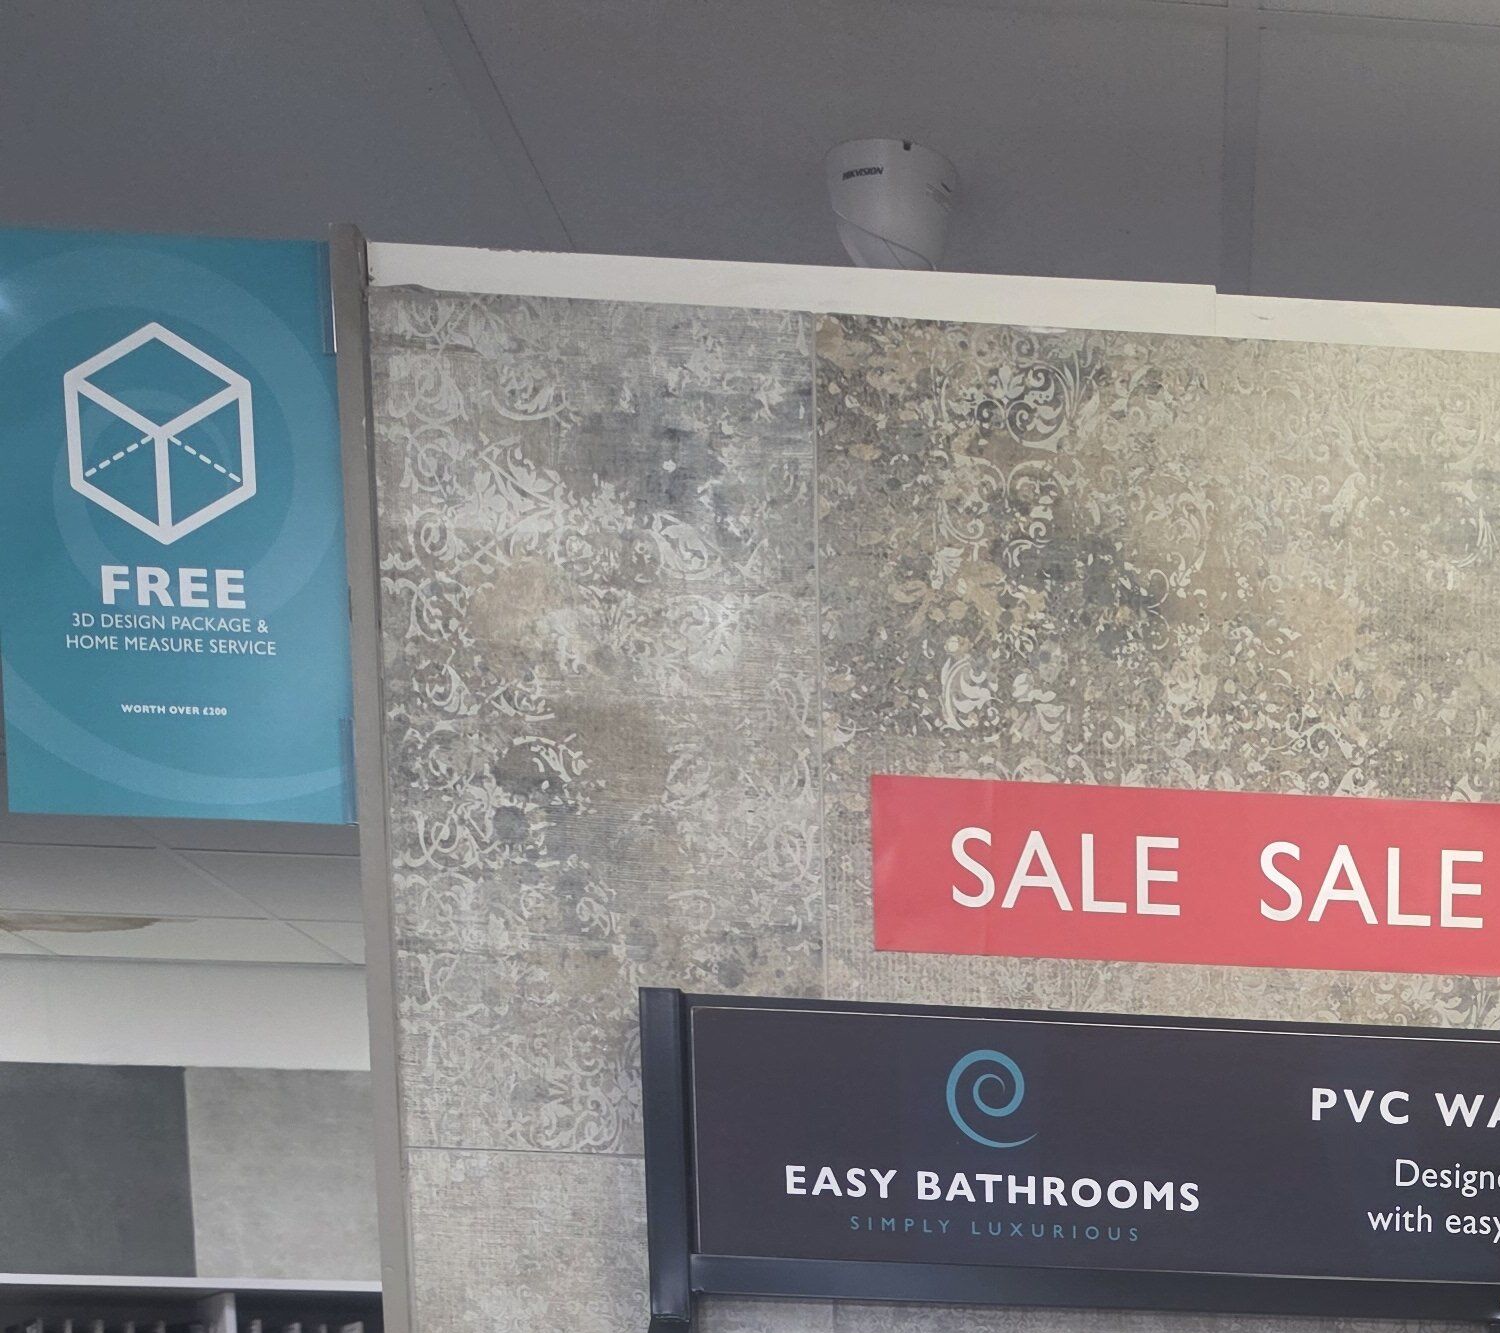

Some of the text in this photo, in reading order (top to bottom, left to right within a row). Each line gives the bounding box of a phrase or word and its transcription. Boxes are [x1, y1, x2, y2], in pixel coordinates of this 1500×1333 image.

[100, 563, 247, 610] FREE
[72, 612, 269, 634] 3D DESIGN PACKAGE &
[66, 633, 277, 656] HOME MEASURE SERVICE
[120, 703, 228, 716] WORTH OVER £200
[951, 825, 1182, 917] SALE
[1259, 840, 1485, 930] SALE
[1310, 1087, 1411, 1125] PVC
[785, 1163, 1201, 1213] EASY BATHROOMS
[849, 1215, 1139, 1243] SIMPLY LUXURIOUS
[1366, 1204, 1433, 1234] with
